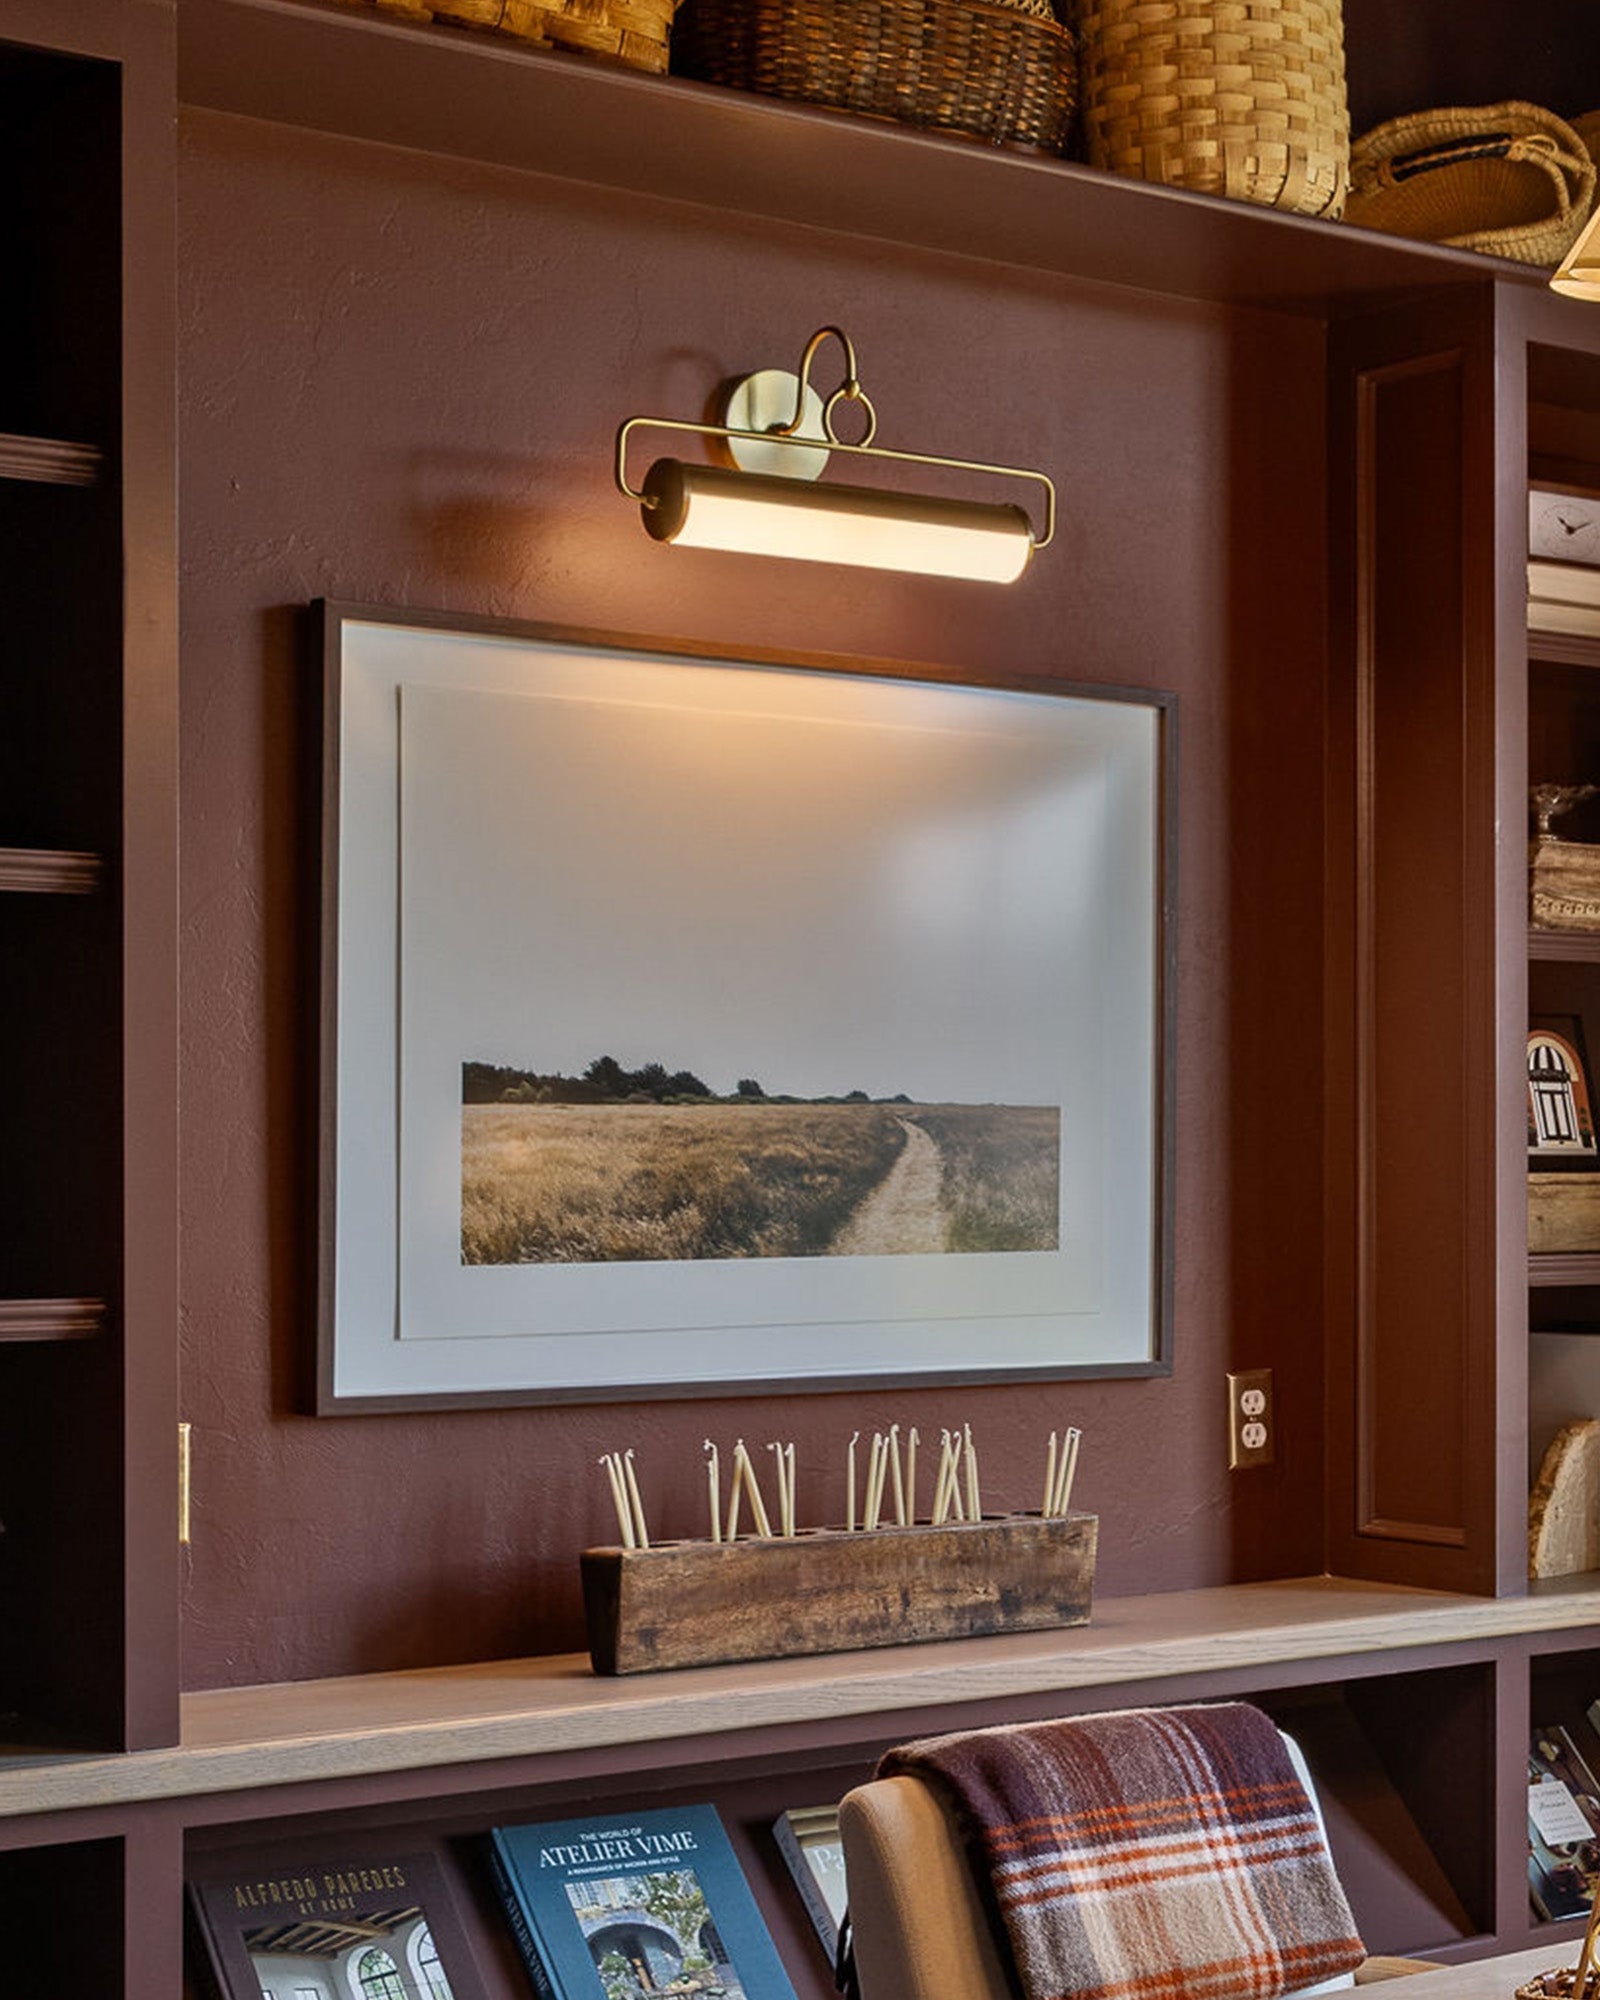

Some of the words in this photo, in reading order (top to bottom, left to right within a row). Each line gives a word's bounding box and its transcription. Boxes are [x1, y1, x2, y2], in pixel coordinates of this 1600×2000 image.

[540, 1841, 635, 1868] ATELIER
[639, 1831, 699, 1854] VIME
[579, 1832, 598, 1842] THE
[599, 1829, 630, 1840] WORLD
[630, 1827, 643, 1837] OF
[234, 1877, 317, 1908] ALFREDO
[323, 1866, 406, 1896] PAREDES
